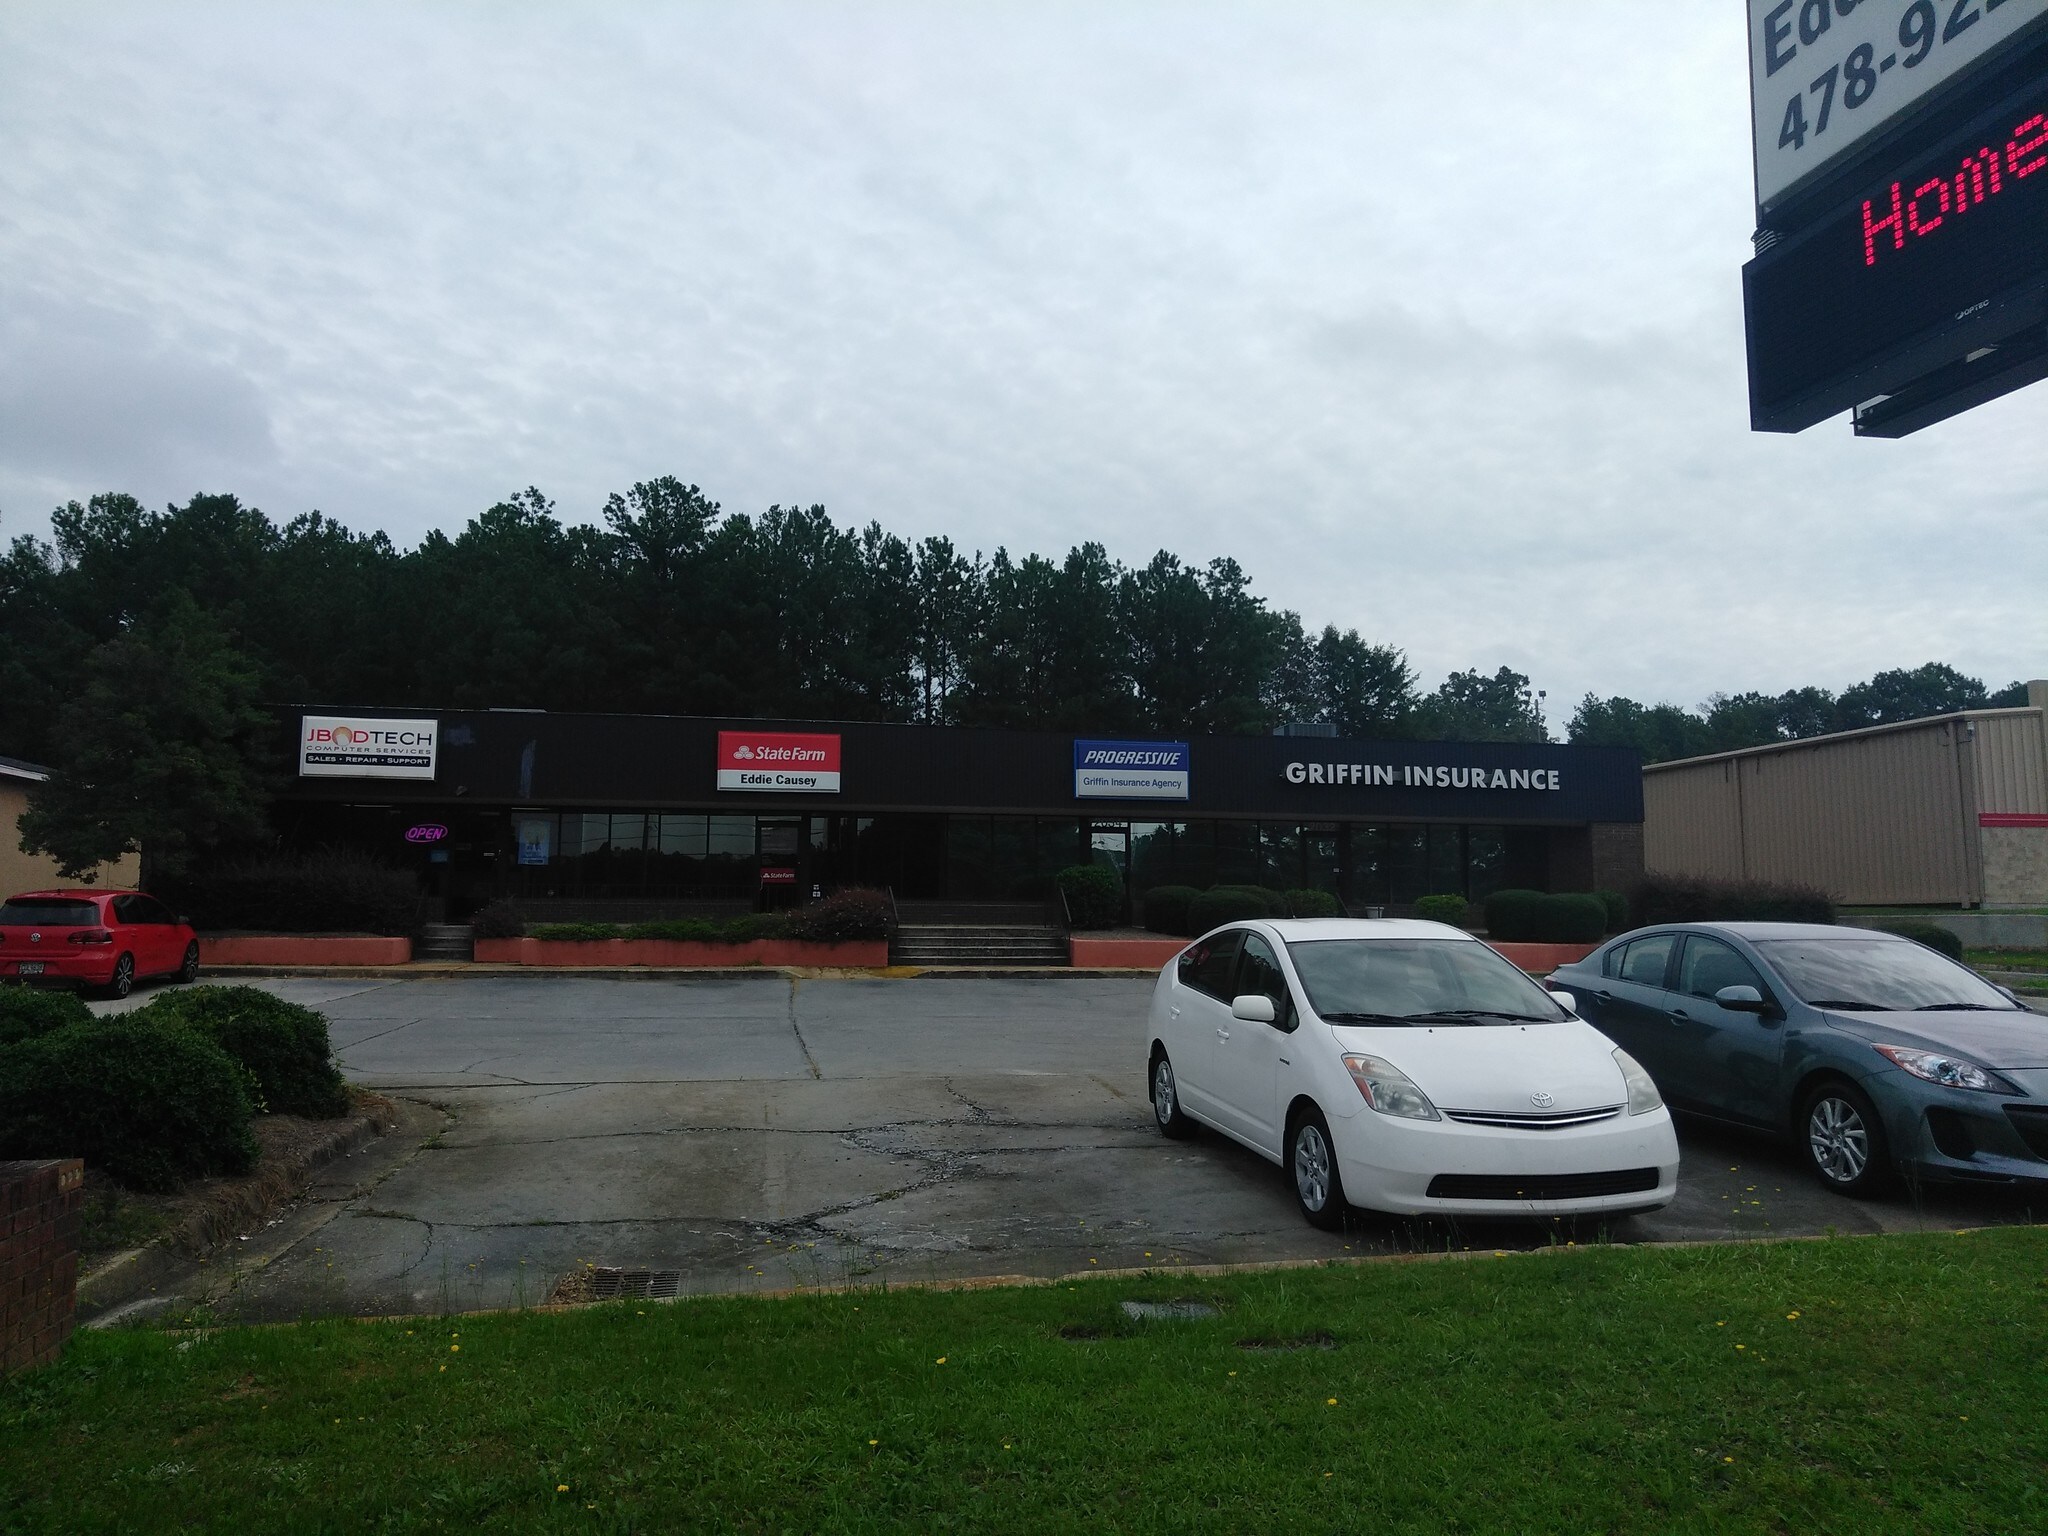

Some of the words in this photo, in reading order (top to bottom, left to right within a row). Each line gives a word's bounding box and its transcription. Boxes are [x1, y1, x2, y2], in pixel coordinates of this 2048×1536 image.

[1862, 112, 2048, 267] Home
[306, 745, 370, 753] COMPUTER
[376, 747, 431, 755] SERVICES
[1084, 750, 1181, 766] PROGRESSIVE
[740, 773, 773, 785] Eddie
[775, 774, 817, 788] Causey
[1083, 777, 1109, 786] Griffin
[1111, 778, 1151, 787] Insurance
[1152, 779, 1182, 789] Agency
[1286, 762, 1394, 786] GRIFFIN
[1404, 766, 1560, 791] INSURANCE
[407, 827, 444, 840] OPEN
